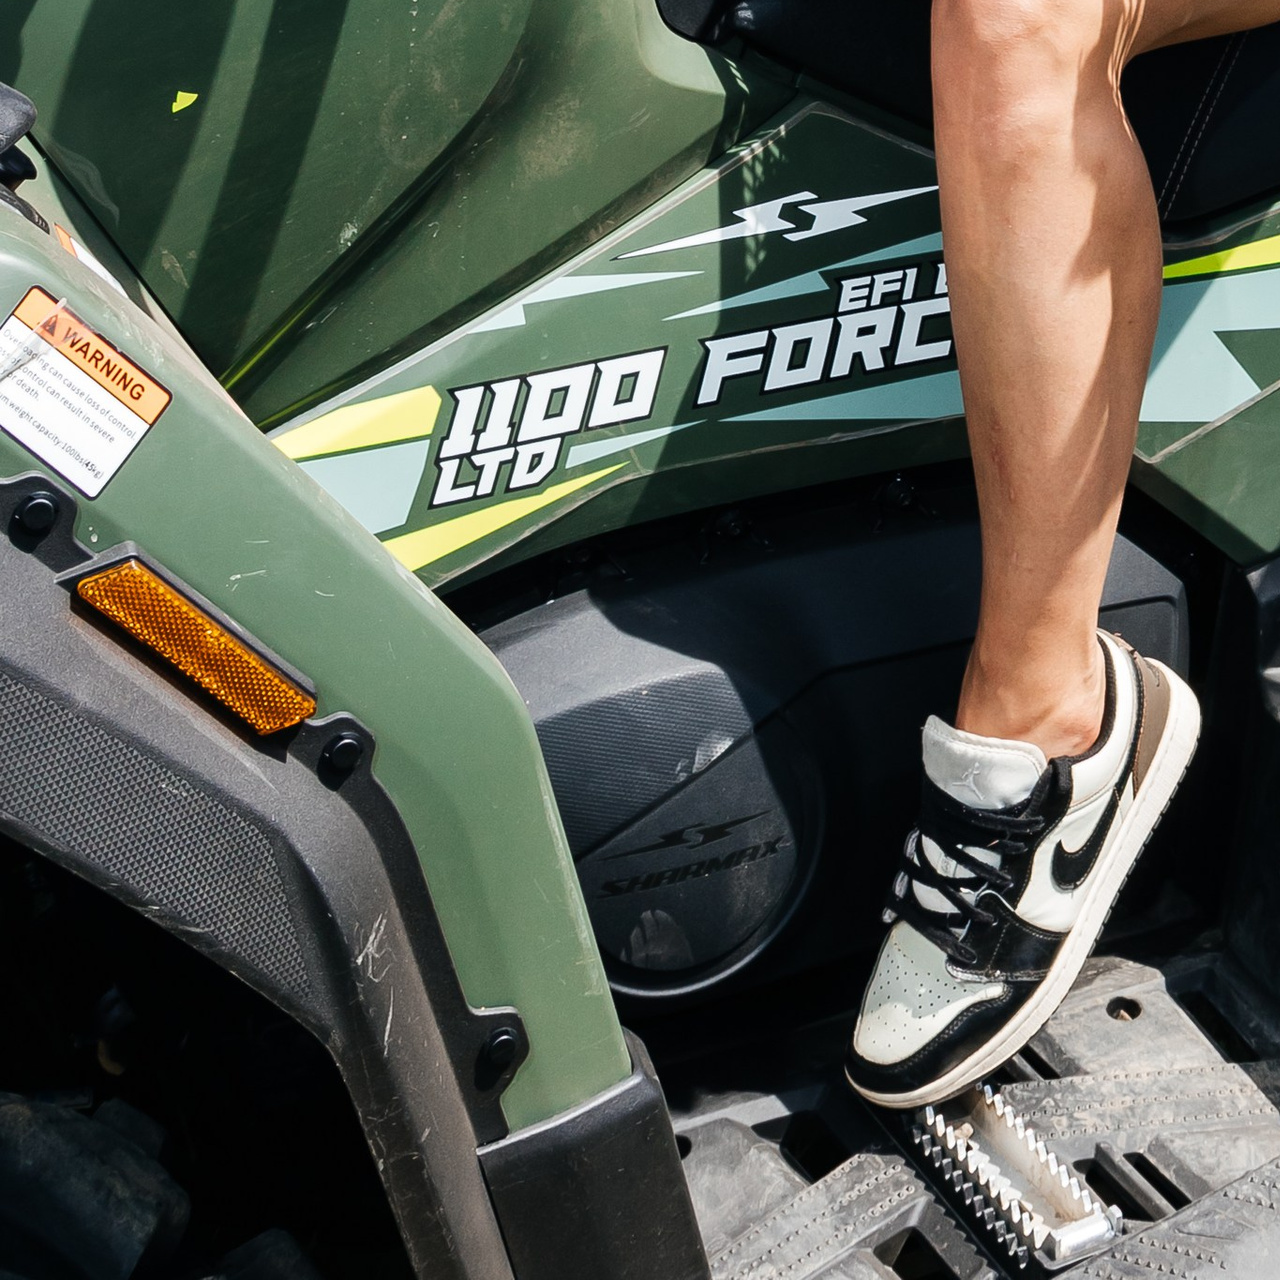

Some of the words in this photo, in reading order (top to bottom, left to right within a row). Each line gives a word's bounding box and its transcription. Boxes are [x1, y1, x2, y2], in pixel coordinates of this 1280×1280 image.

[837, 266, 918, 313] EFI
[48, 367, 63, 382] can
[62, 377, 85, 399] cause
[84, 392, 100, 411] loss
[63, 326, 146, 401] WARNING
[438, 349, 665, 459] 1100
[696, 296, 952, 405] FORC
[46, 385, 61, 402] can
[61, 397, 83, 419] result
[90, 420, 116, 444] severe
[430, 437, 563, 507] LTD
[598, 835, 785, 899] SHARMAX
